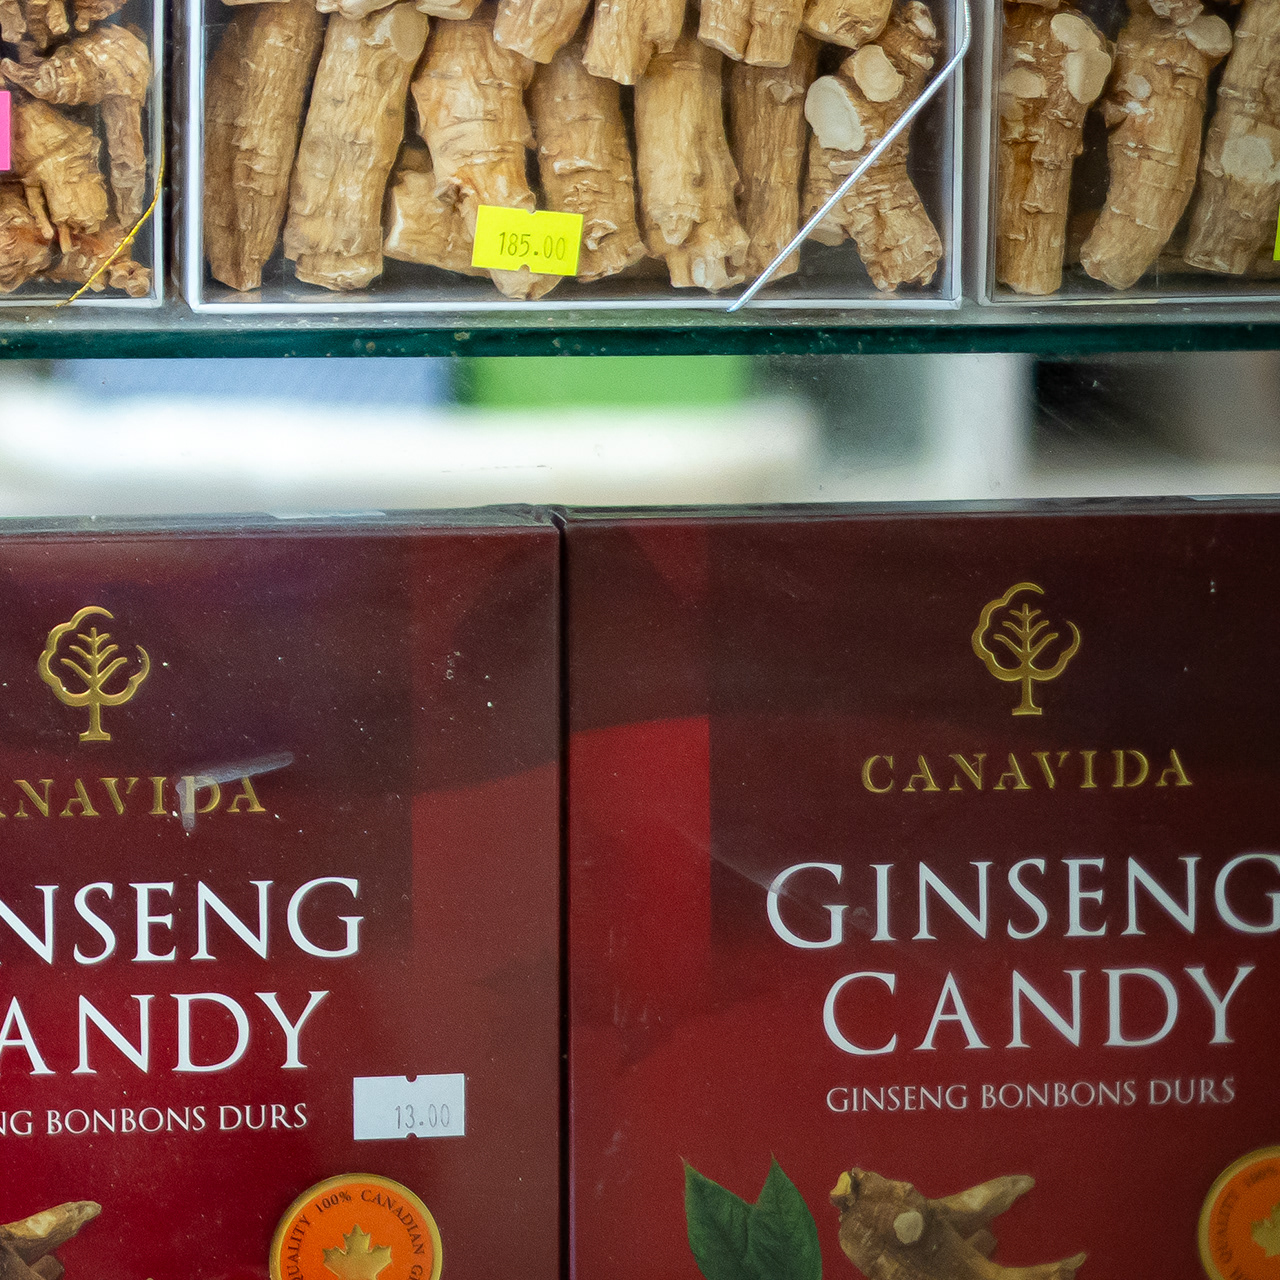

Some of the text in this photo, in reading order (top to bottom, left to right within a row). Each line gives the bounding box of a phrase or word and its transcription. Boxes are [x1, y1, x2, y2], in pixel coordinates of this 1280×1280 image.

[499, 231, 566, 261] 185.00
[861, 748, 1194, 794] CANAVIDA
[766, 853, 1280, 949] GINSENG
[822, 966, 1255, 1056] CANDY
[826, 1078, 1236, 1113] GINSENG BONBONS DURS
[46, 1105, 206, 1134] BONBONS
[218, 1102, 308, 1131] DURS
[395, 1103, 449, 1129] 13.00
[287, 1189, 425, 1280] UALITY 100% CANADIAN
